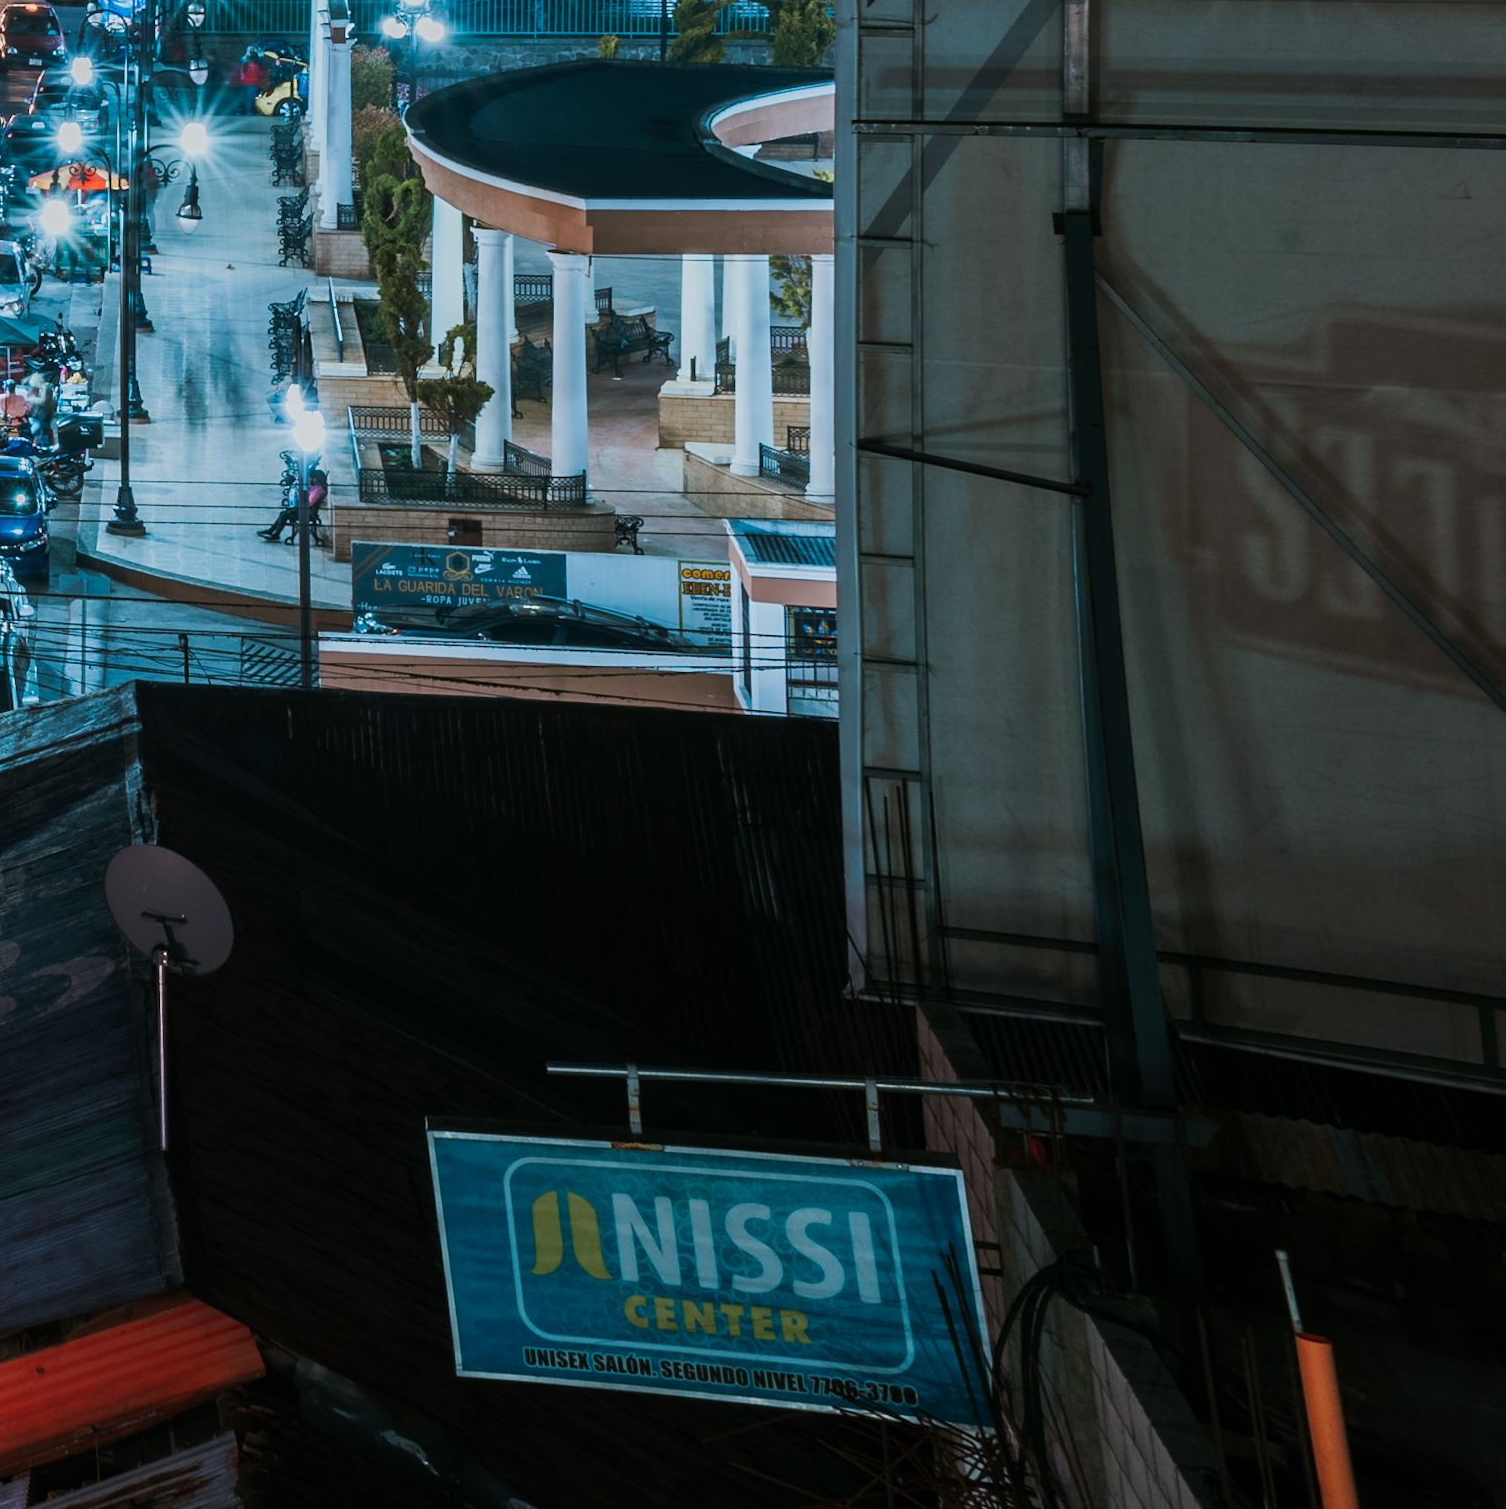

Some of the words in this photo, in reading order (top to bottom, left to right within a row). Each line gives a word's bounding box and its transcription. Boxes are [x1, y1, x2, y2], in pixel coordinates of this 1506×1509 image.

[374, 578, 392, 592] LA
[398, 579, 456, 594] GUARIDA
[462, 583, 490, 597] DEL
[611, 1192, 882, 1304] NISSI
[623, 1294, 812, 1345] CENTER
[523, 1347, 590, 1373] UNISEX
[660, 1359, 749, 1387] SEGUNDO
[753, 1368, 807, 1394] NIVEL
